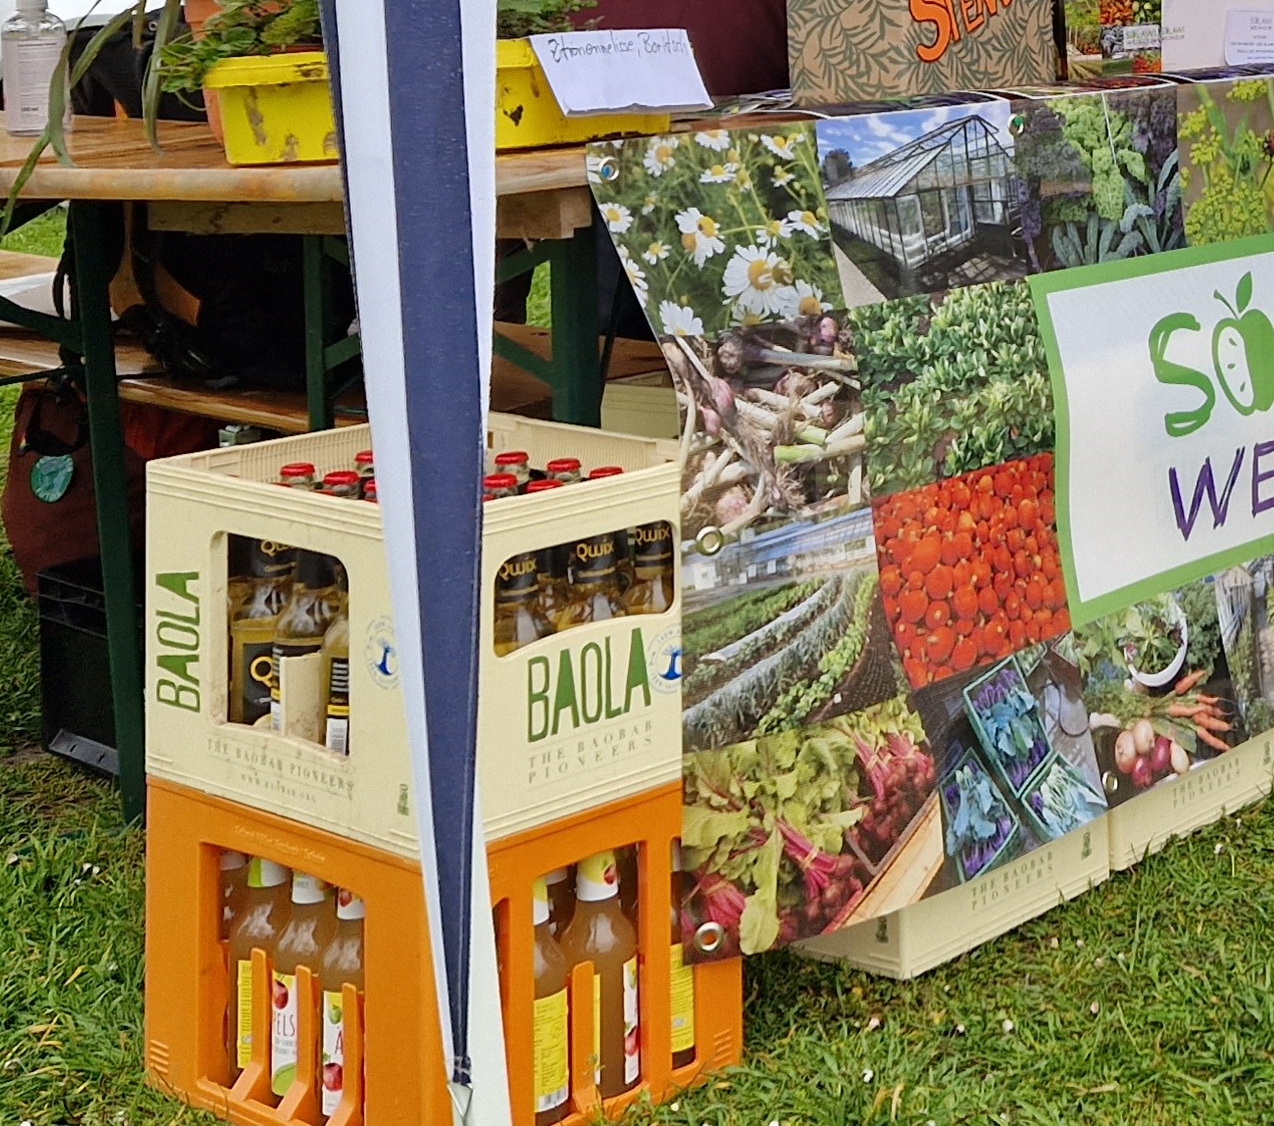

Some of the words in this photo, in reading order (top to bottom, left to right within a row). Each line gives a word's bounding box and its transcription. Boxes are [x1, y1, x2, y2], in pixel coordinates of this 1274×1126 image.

[155, 571, 200, 714] BAOLA
[527, 627, 652, 743] BAOLA
[529, 747, 565, 768] THE
[577, 721, 652, 753] BAOBAB
[529, 738, 652, 783] PIONEERS
